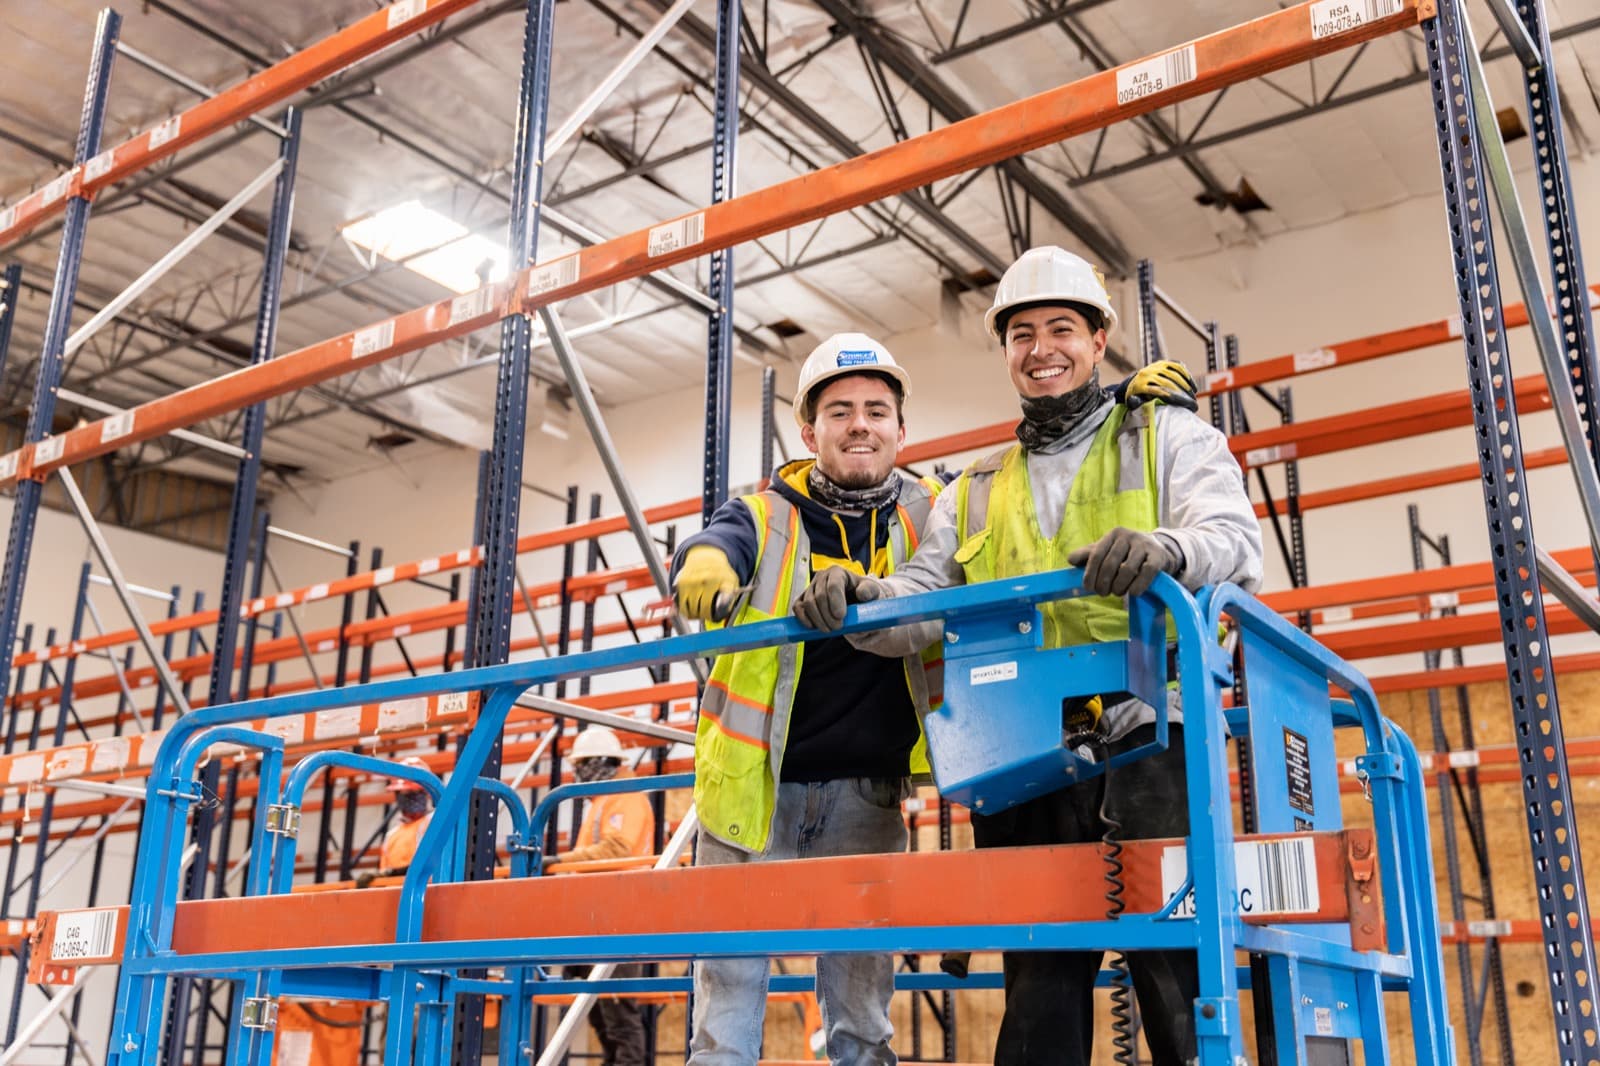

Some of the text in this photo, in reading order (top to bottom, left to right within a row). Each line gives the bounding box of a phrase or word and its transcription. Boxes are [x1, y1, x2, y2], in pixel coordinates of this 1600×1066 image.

[1329, 4, 1350, 19] RSA
[1318, 12, 1362, 37] 009-078-A
[1118, 78, 1163, 103] 009-078-B
[66, 926, 81, 939] C4G
